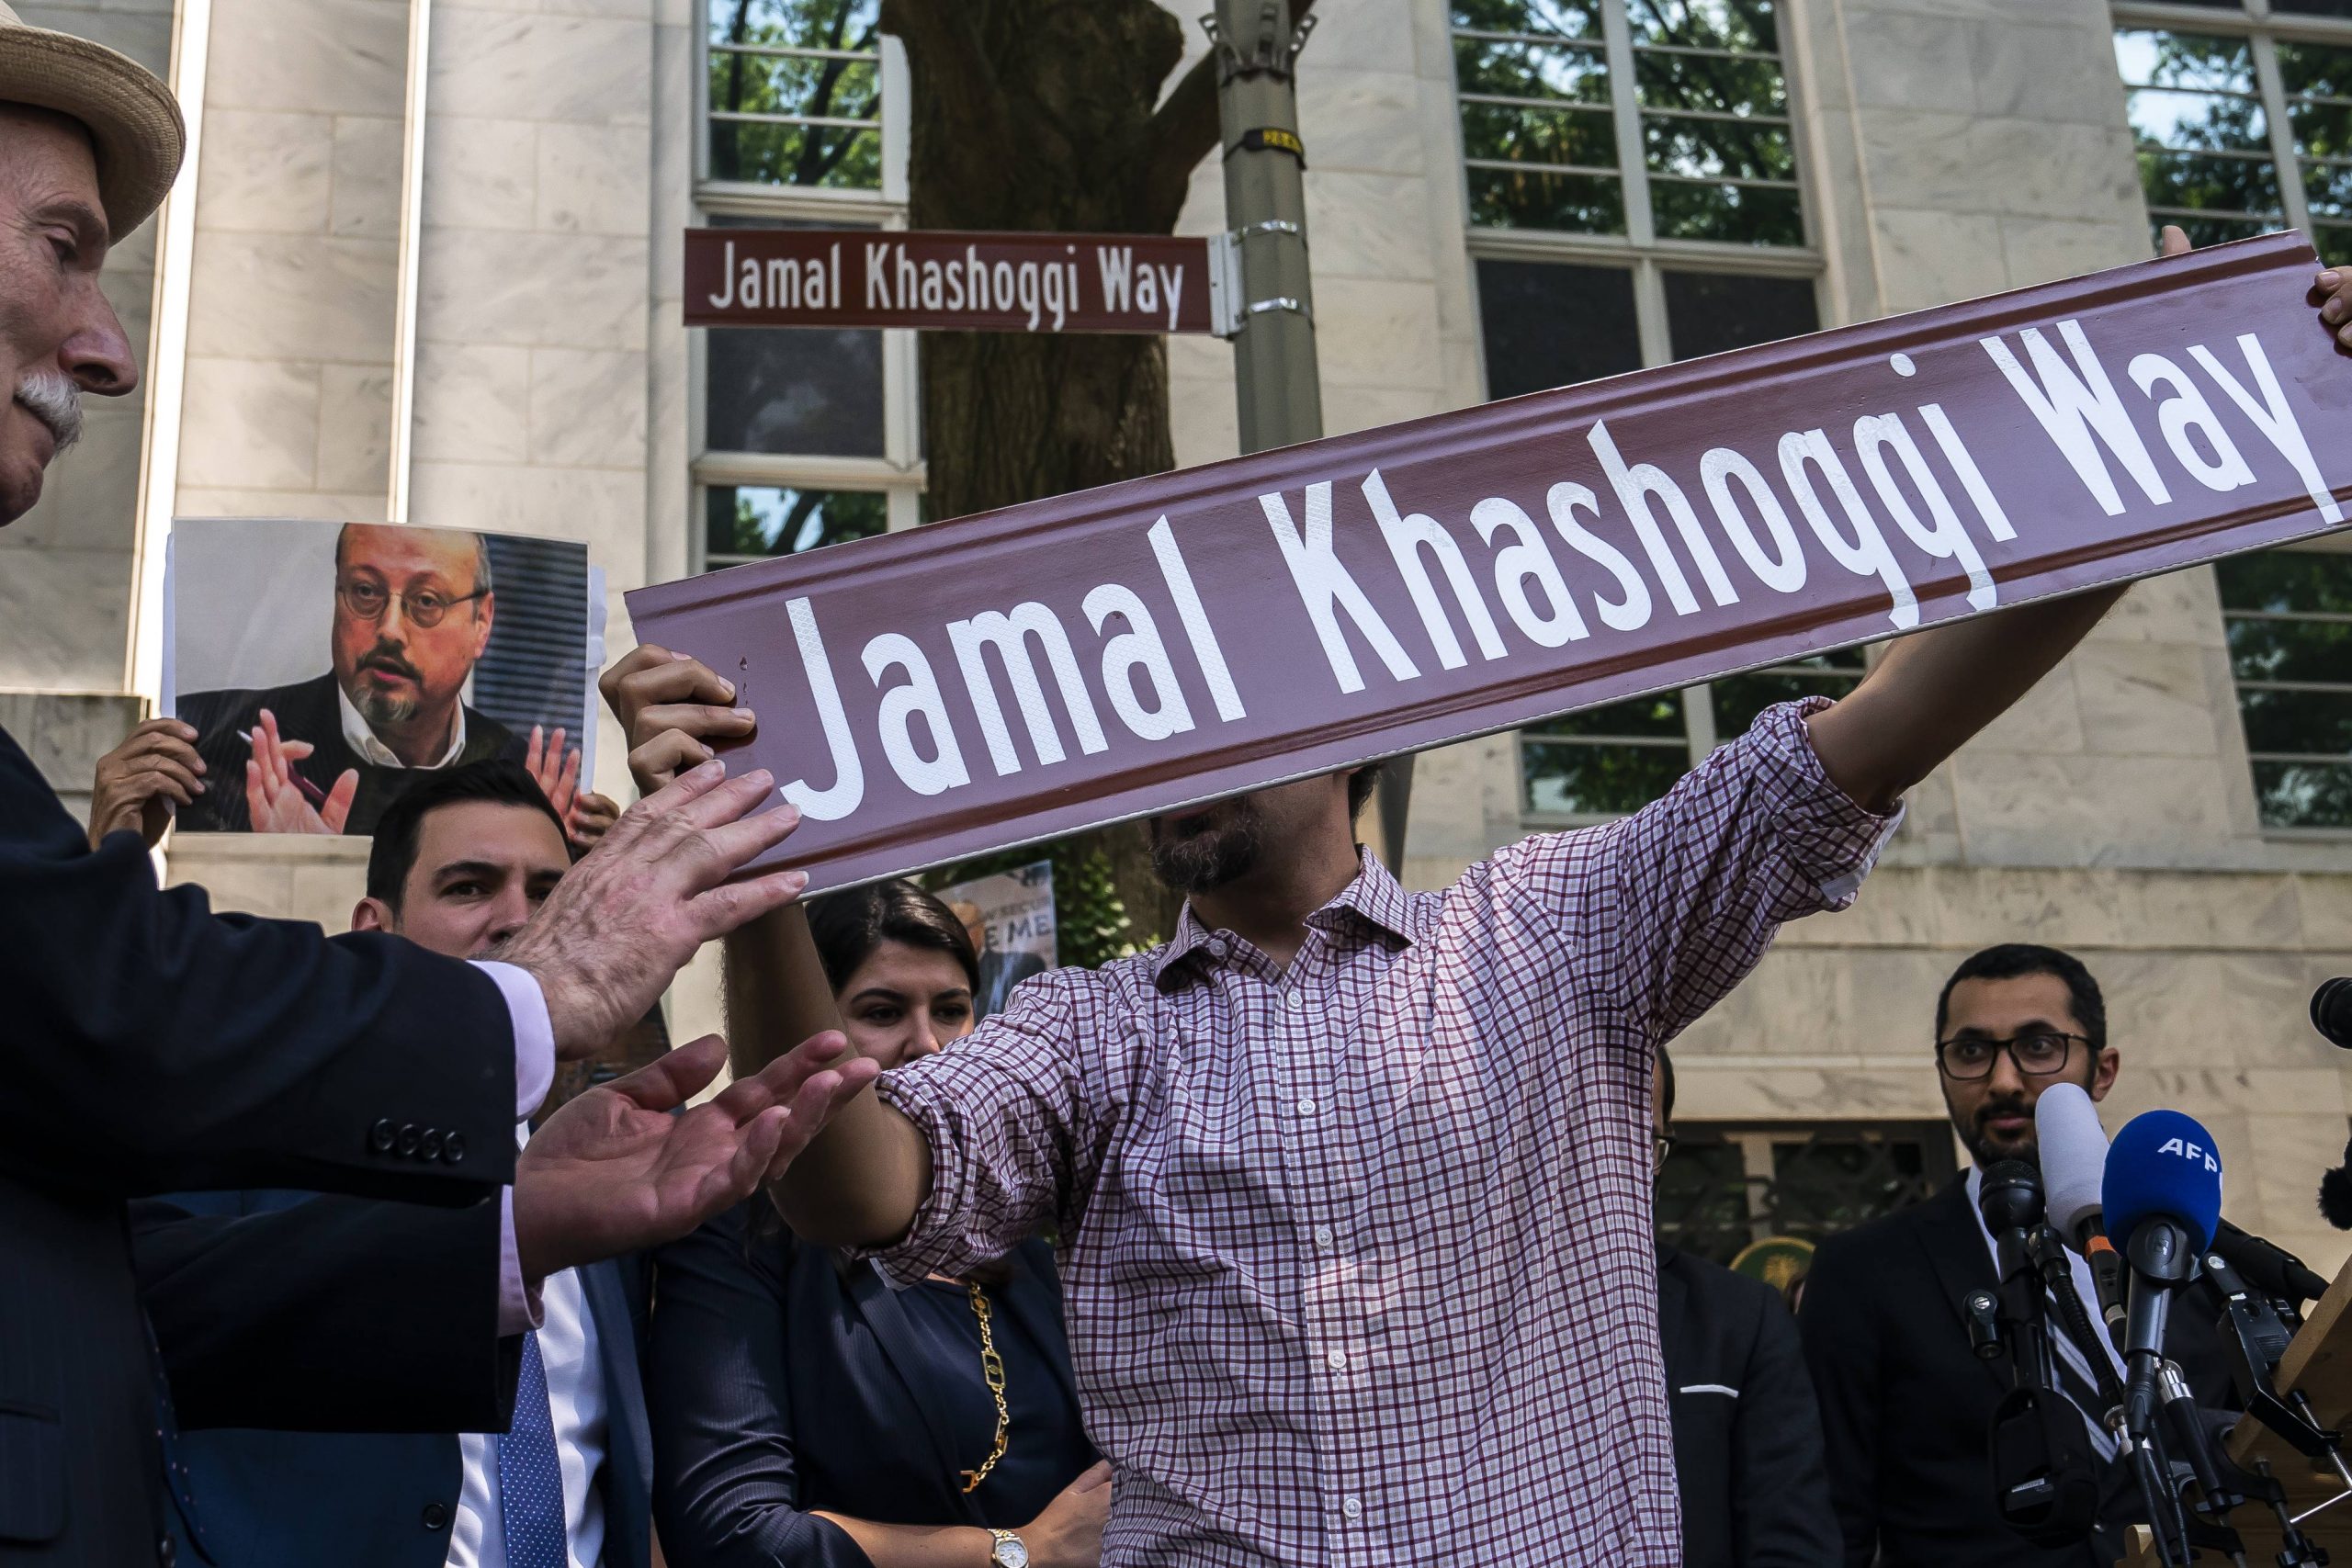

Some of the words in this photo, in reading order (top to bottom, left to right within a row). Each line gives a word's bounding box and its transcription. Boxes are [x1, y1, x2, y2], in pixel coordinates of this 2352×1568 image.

[708, 241, 841, 310] Jamal
[865, 243, 1080, 333] Khashoggi
[1097, 246, 1184, 332] Way
[779, 513, 1247, 820] Jamal
[1258, 352, 2018, 695] Khashoggi
[1978, 318, 2345, 525] Way
[2157, 1137, 2218, 1173] AFP
